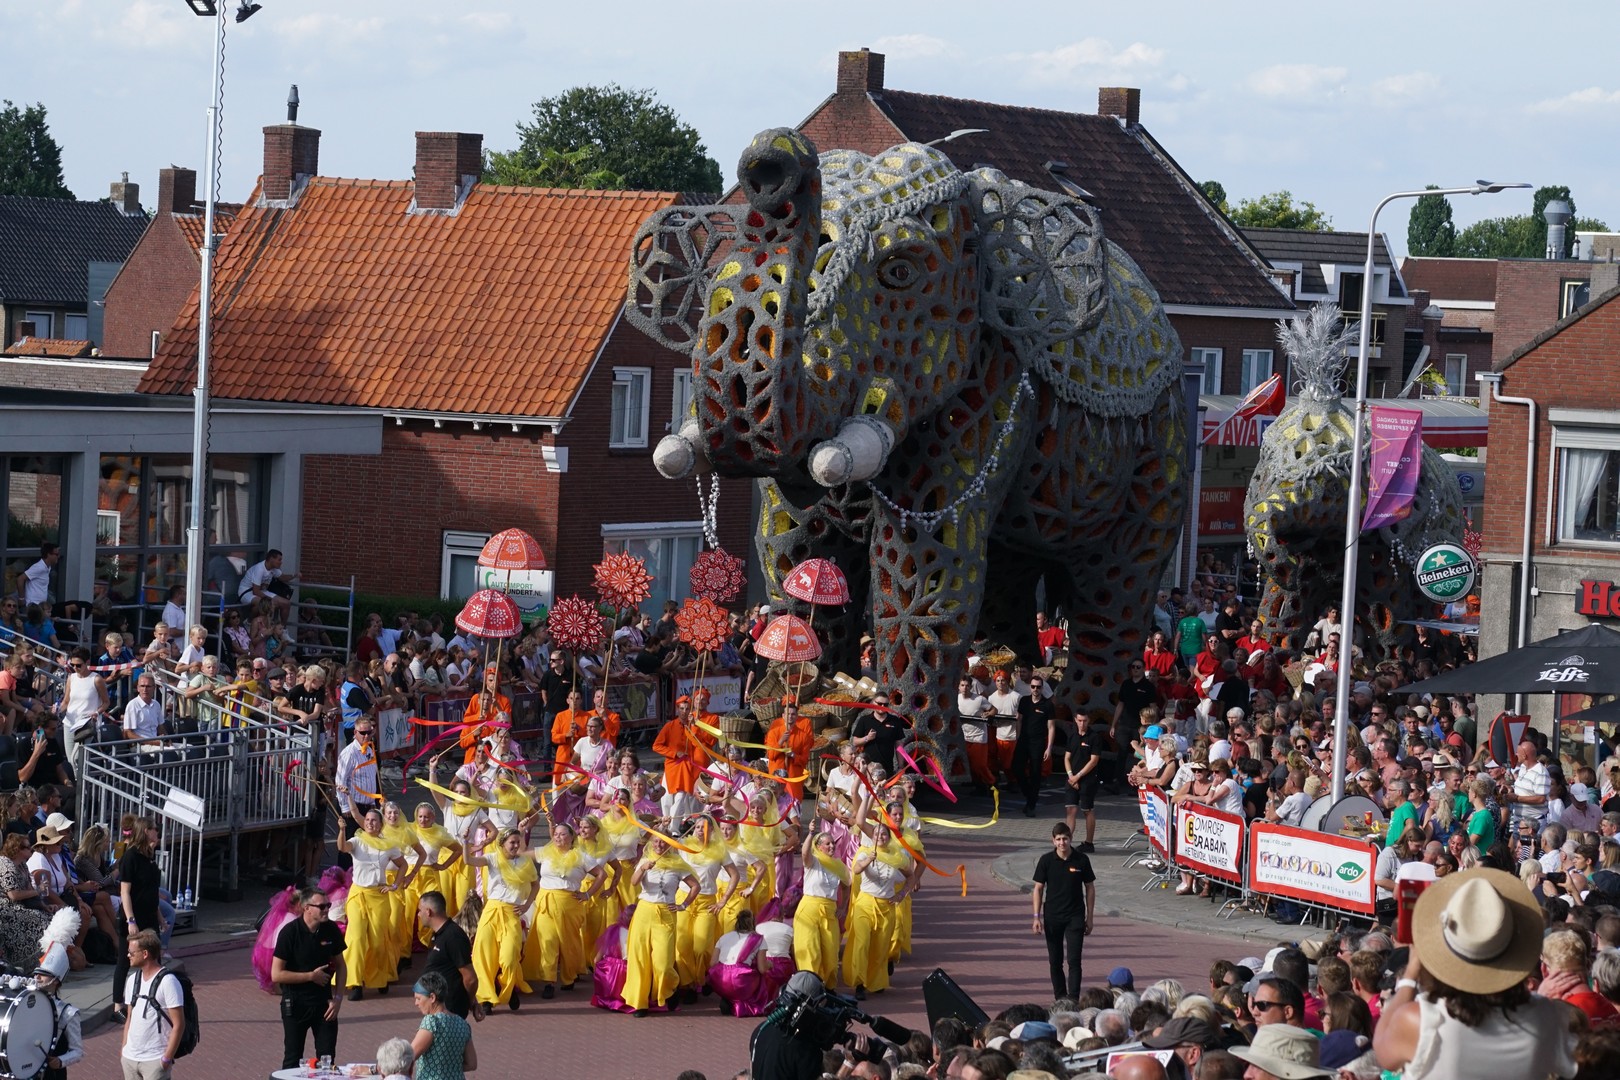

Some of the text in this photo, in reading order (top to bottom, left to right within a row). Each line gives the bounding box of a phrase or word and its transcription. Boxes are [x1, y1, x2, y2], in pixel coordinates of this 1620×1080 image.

[1419, 563, 1470, 585] Heineken
[491, 581, 533, 589] AUTOMPORT
[1535, 667, 1590, 683] Leffe
[1339, 865, 1359, 877] ardo
